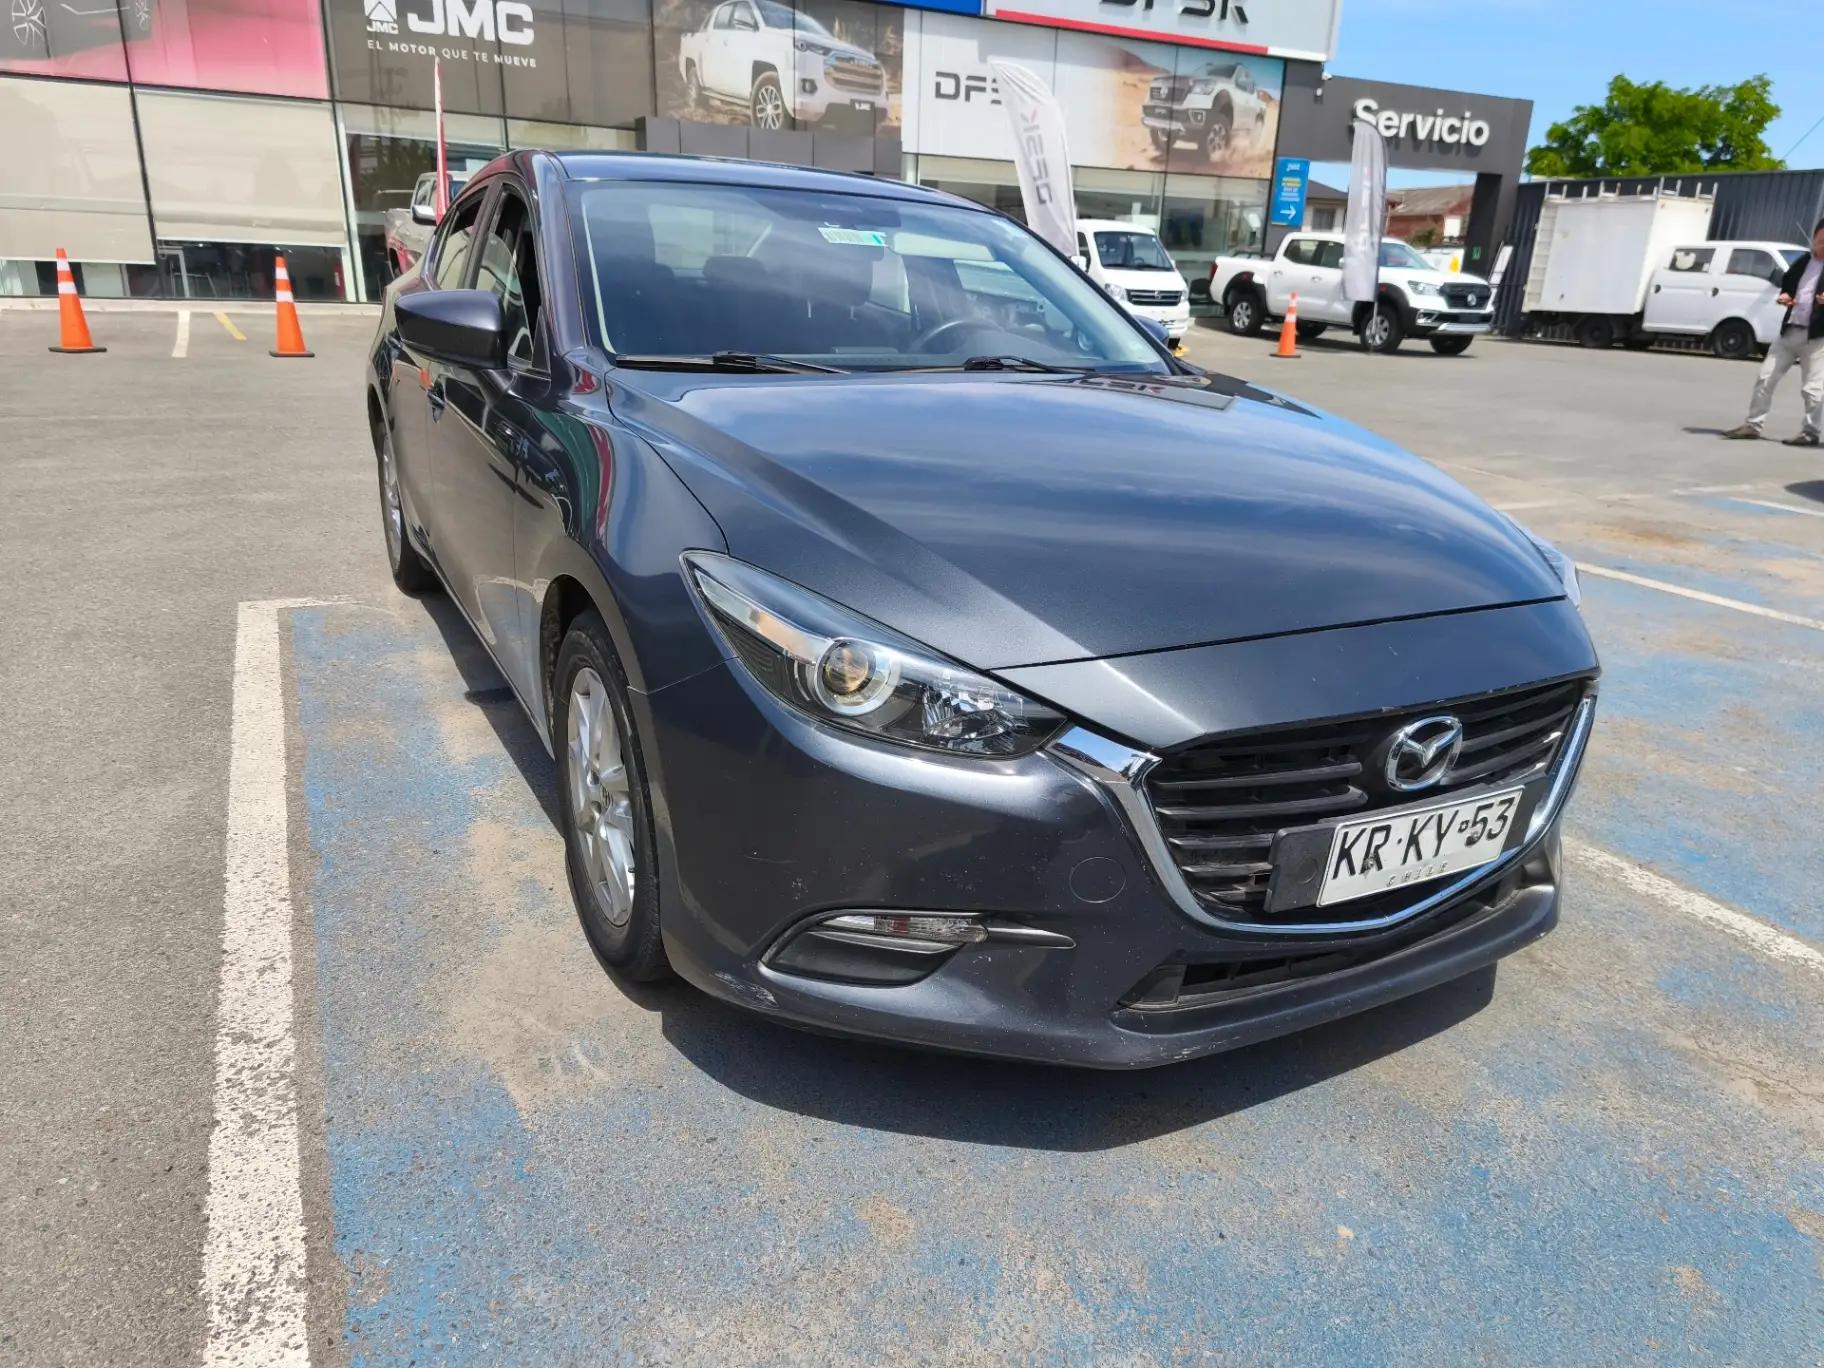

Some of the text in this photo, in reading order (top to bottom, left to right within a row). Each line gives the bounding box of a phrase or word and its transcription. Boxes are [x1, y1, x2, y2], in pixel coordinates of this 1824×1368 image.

[366, 20, 399, 35] JMC
[407, 0, 534, 46] JMC
[367, 39, 537, 68] EL MOTOR QUE TE MUEVE
[1353, 98, 1490, 146] Servicio
